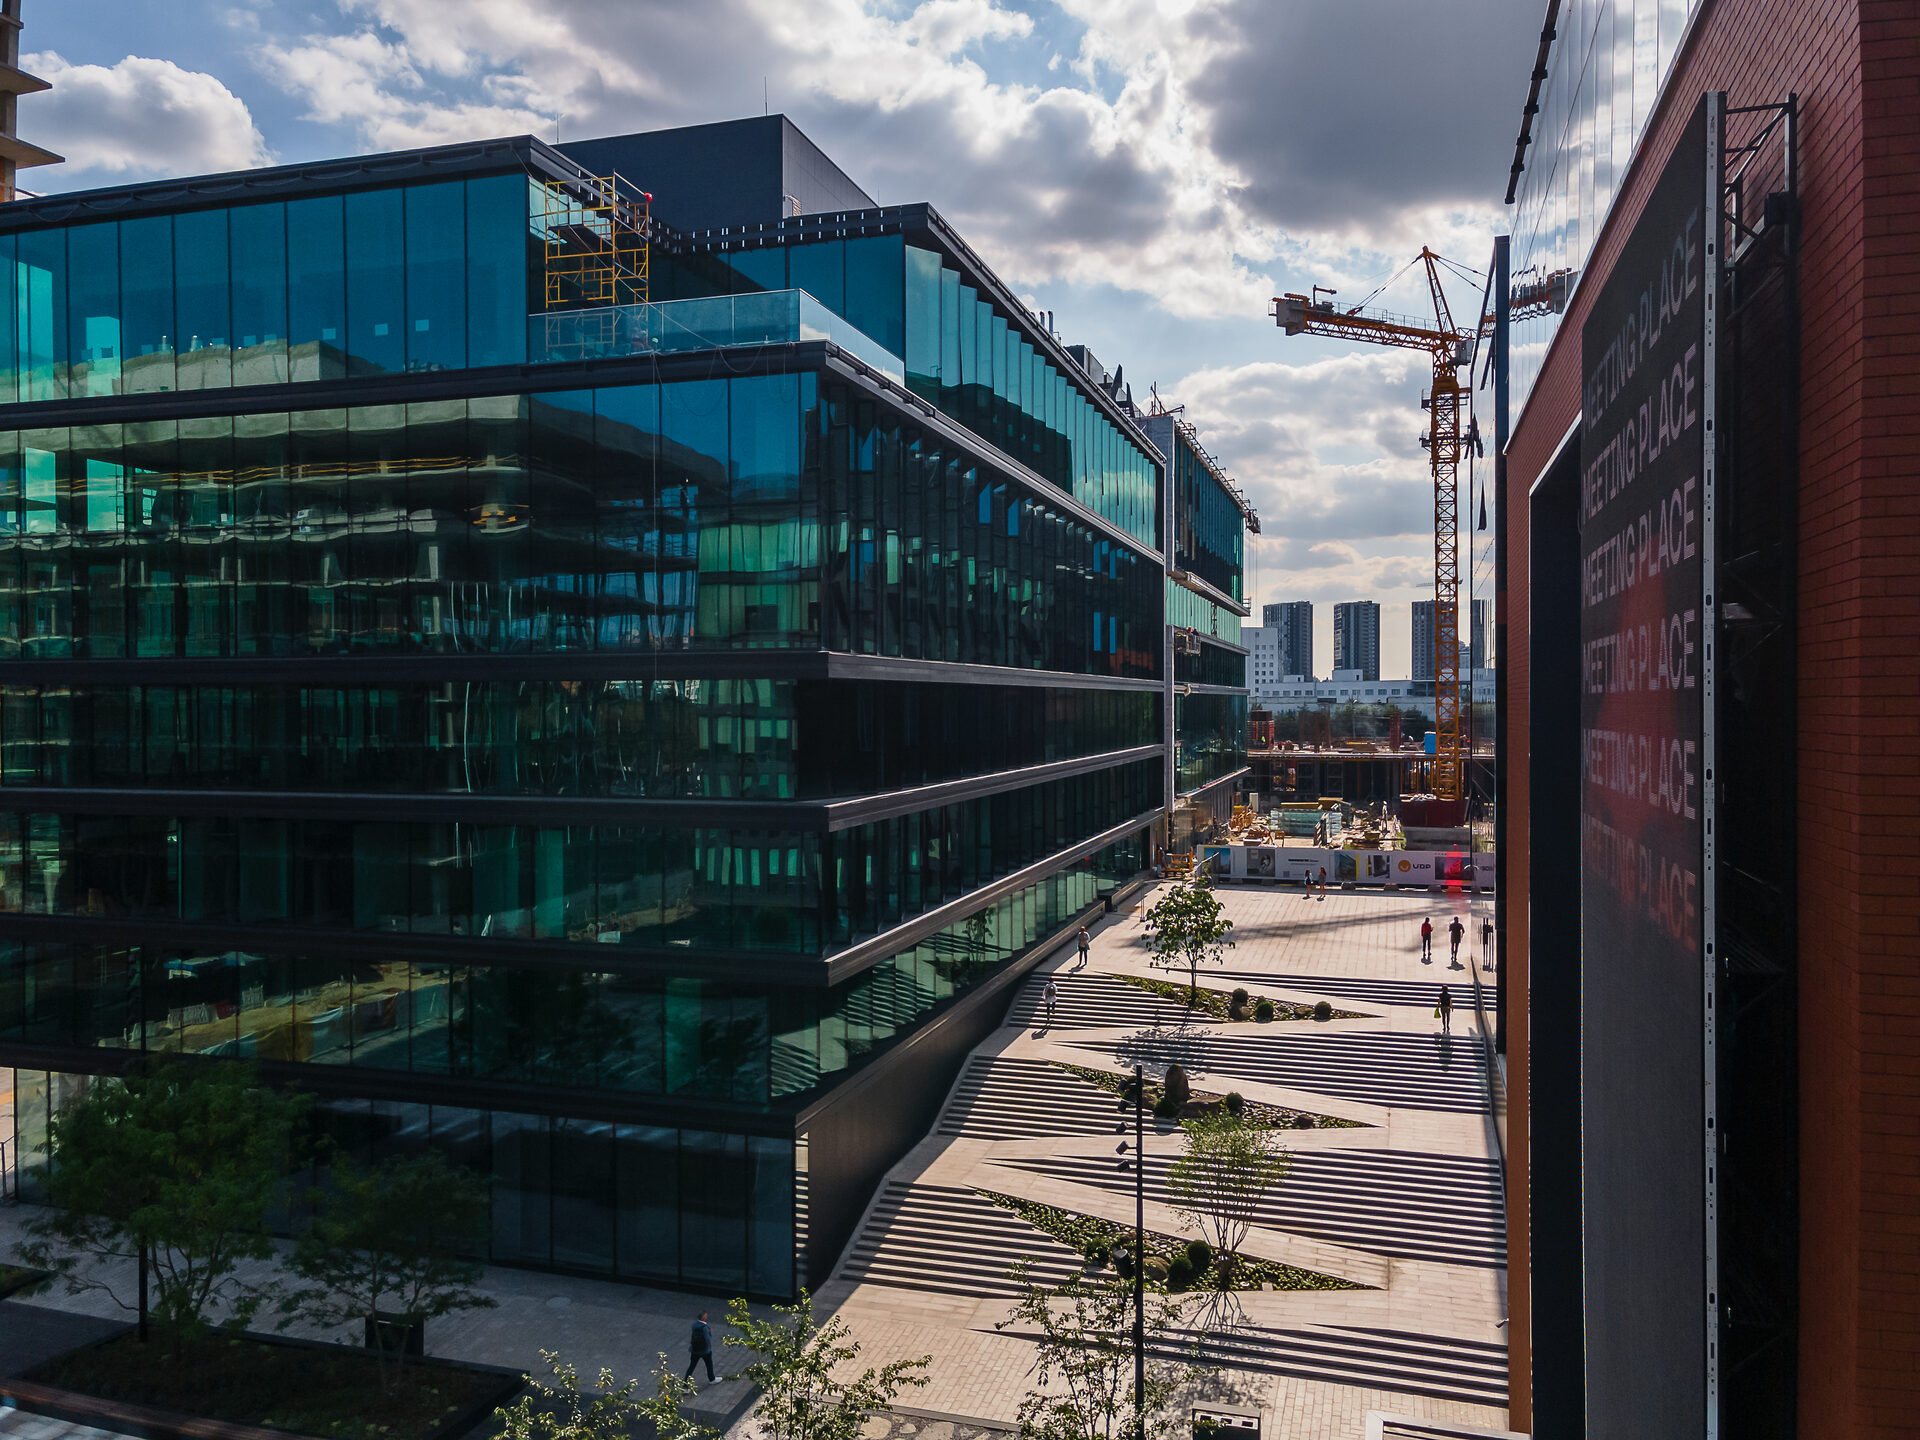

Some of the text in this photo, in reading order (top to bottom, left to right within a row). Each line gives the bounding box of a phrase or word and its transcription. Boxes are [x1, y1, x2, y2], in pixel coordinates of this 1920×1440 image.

[1582, 342, 1696, 525] MEETING PLACE
[1582, 476, 1696, 607] MEETING PLACE
[1582, 609, 1696, 695] MEETING PLACE
[1582, 728, 1696, 820] MEETING PLACE
